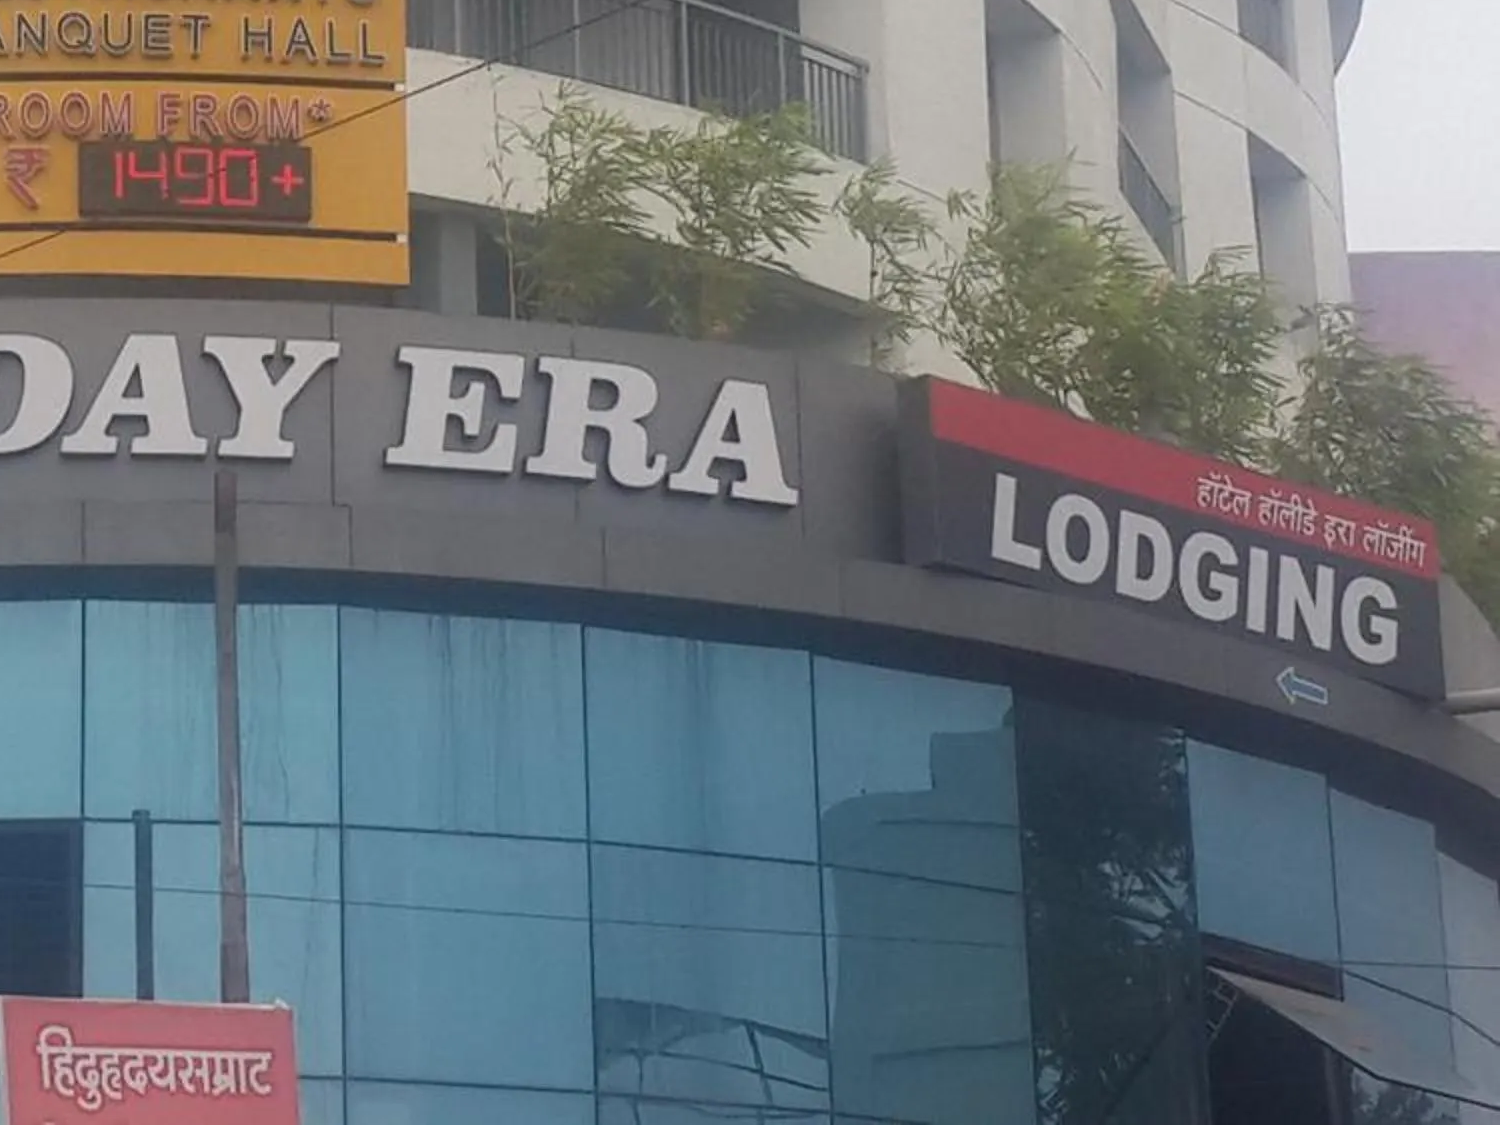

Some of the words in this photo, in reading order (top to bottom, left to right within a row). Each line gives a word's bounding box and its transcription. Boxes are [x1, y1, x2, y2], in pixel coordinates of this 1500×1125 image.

[239, 17, 386, 66] HALL
[384, 345, 800, 506] ERA
[990, 472, 1399, 665] LODGING
[1196, 471, 1253, 519] हॉटेल
[1323, 514, 1357, 552] इरा
